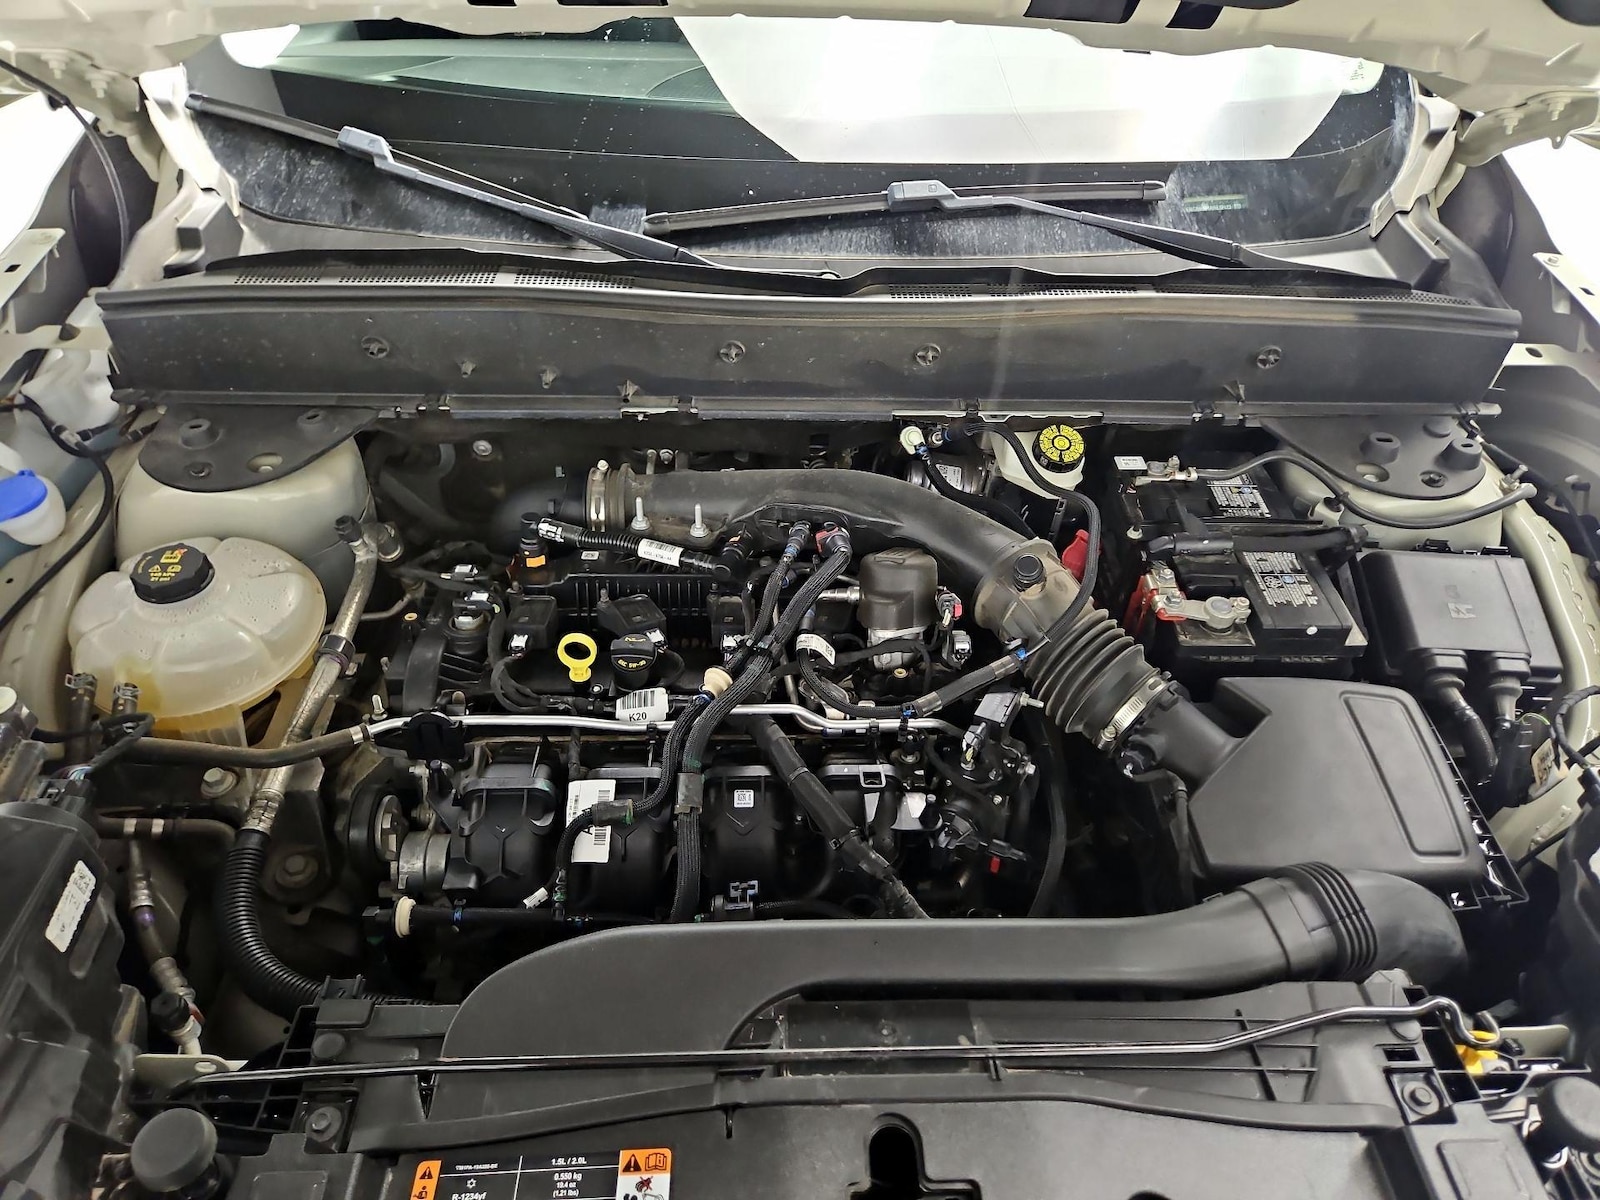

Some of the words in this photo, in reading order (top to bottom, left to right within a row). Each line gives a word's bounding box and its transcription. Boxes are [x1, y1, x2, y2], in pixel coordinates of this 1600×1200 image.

[628, 711, 647, 722] K20
[571, 1156, 587, 1165] 2.0L
[554, 1172, 572, 1181] 0.550
[573, 1172, 582, 1182] kg
[452, 1191, 487, 1200] R-1234yf
